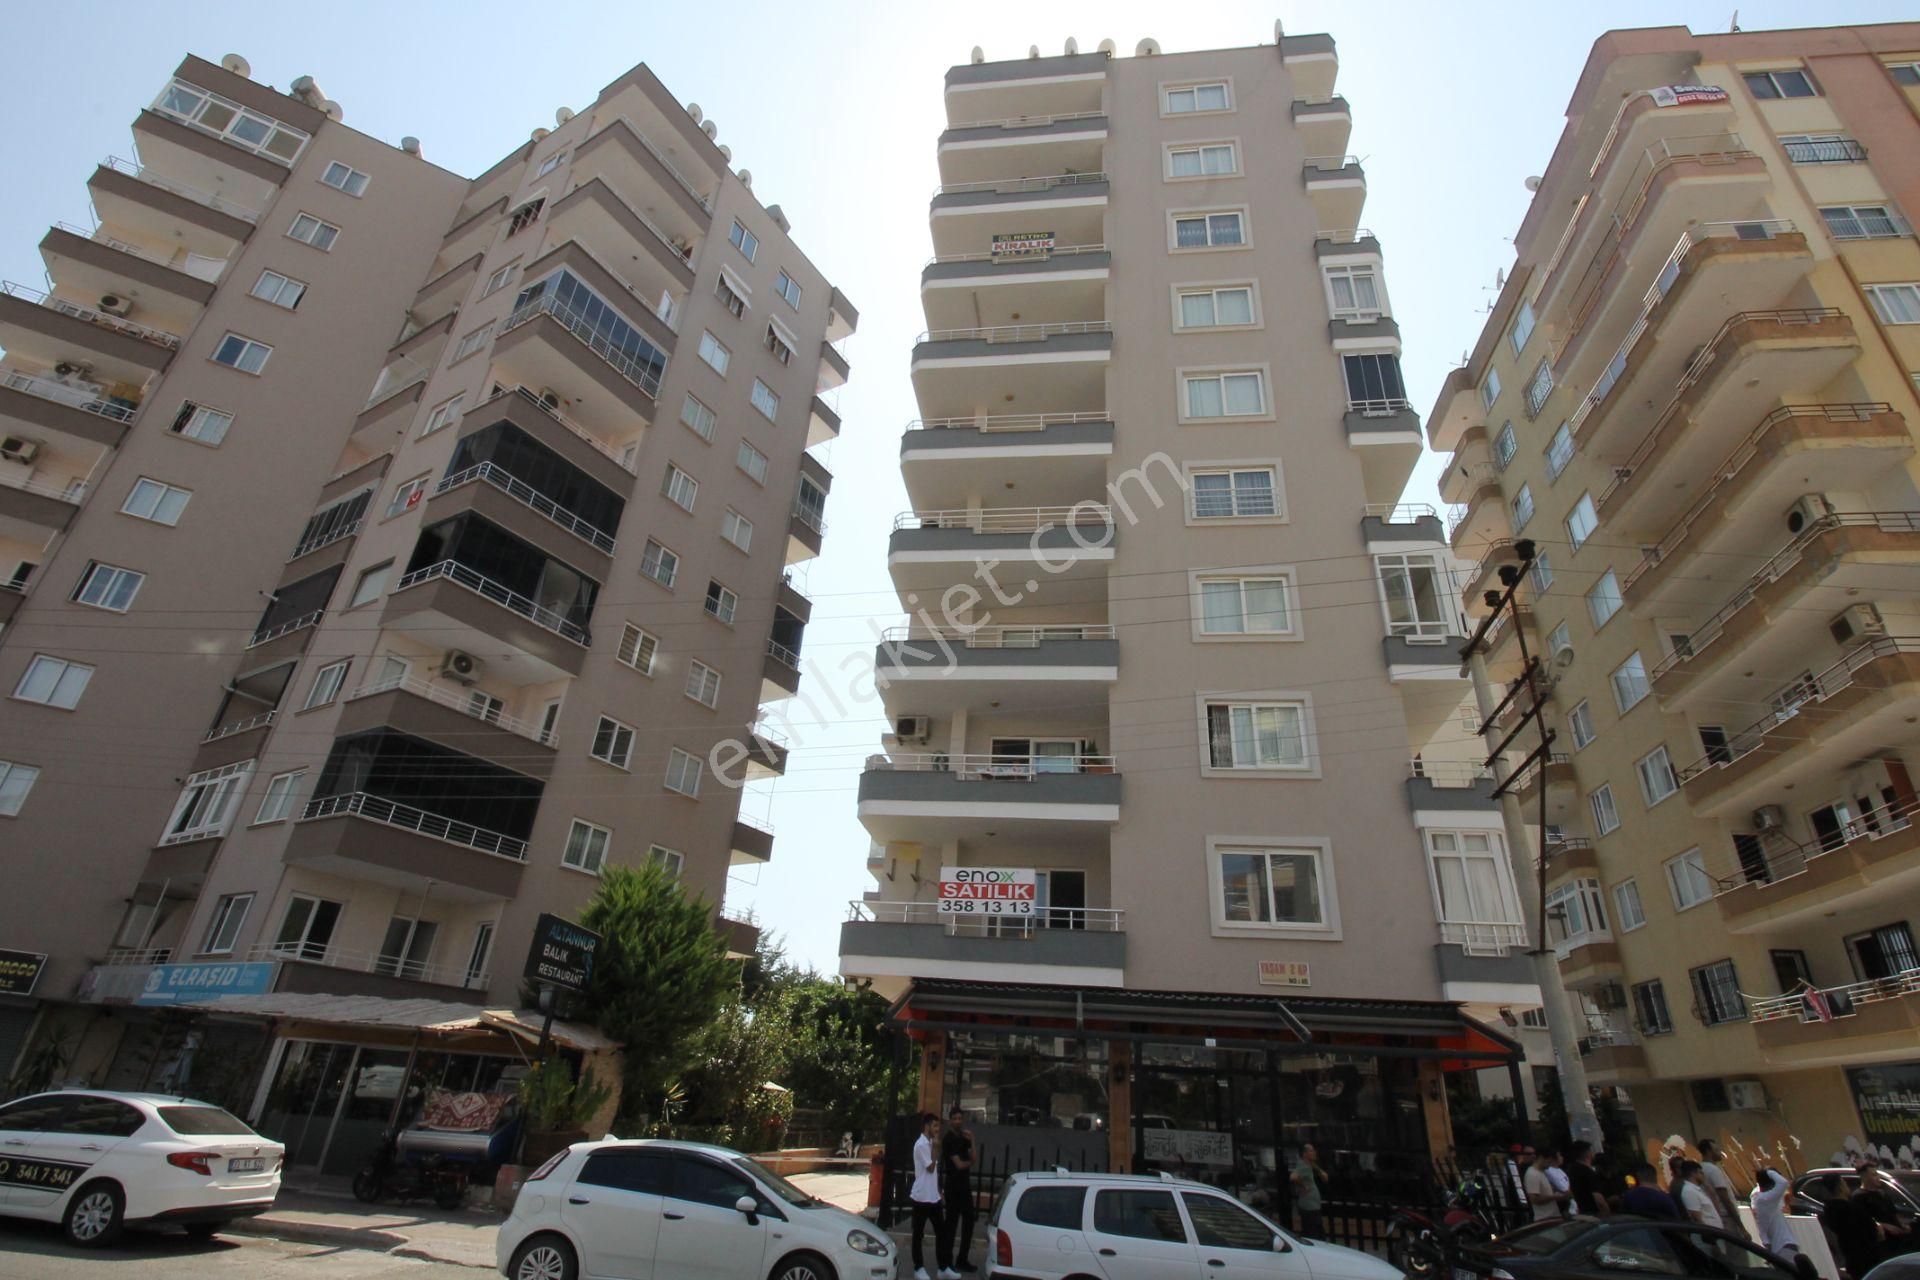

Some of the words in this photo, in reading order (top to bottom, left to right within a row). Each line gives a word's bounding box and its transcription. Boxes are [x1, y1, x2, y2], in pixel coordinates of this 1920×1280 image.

[943, 883, 1032, 899] SATILIK
[942, 900, 974, 912] 358
[982, 901, 1002, 913] 13
[1010, 901, 1030, 913] 13
[548, 925, 596, 953] ALTANNUR
[543, 943, 569, 963] BALIK
[538, 962, 584, 985] RESTAURANT
